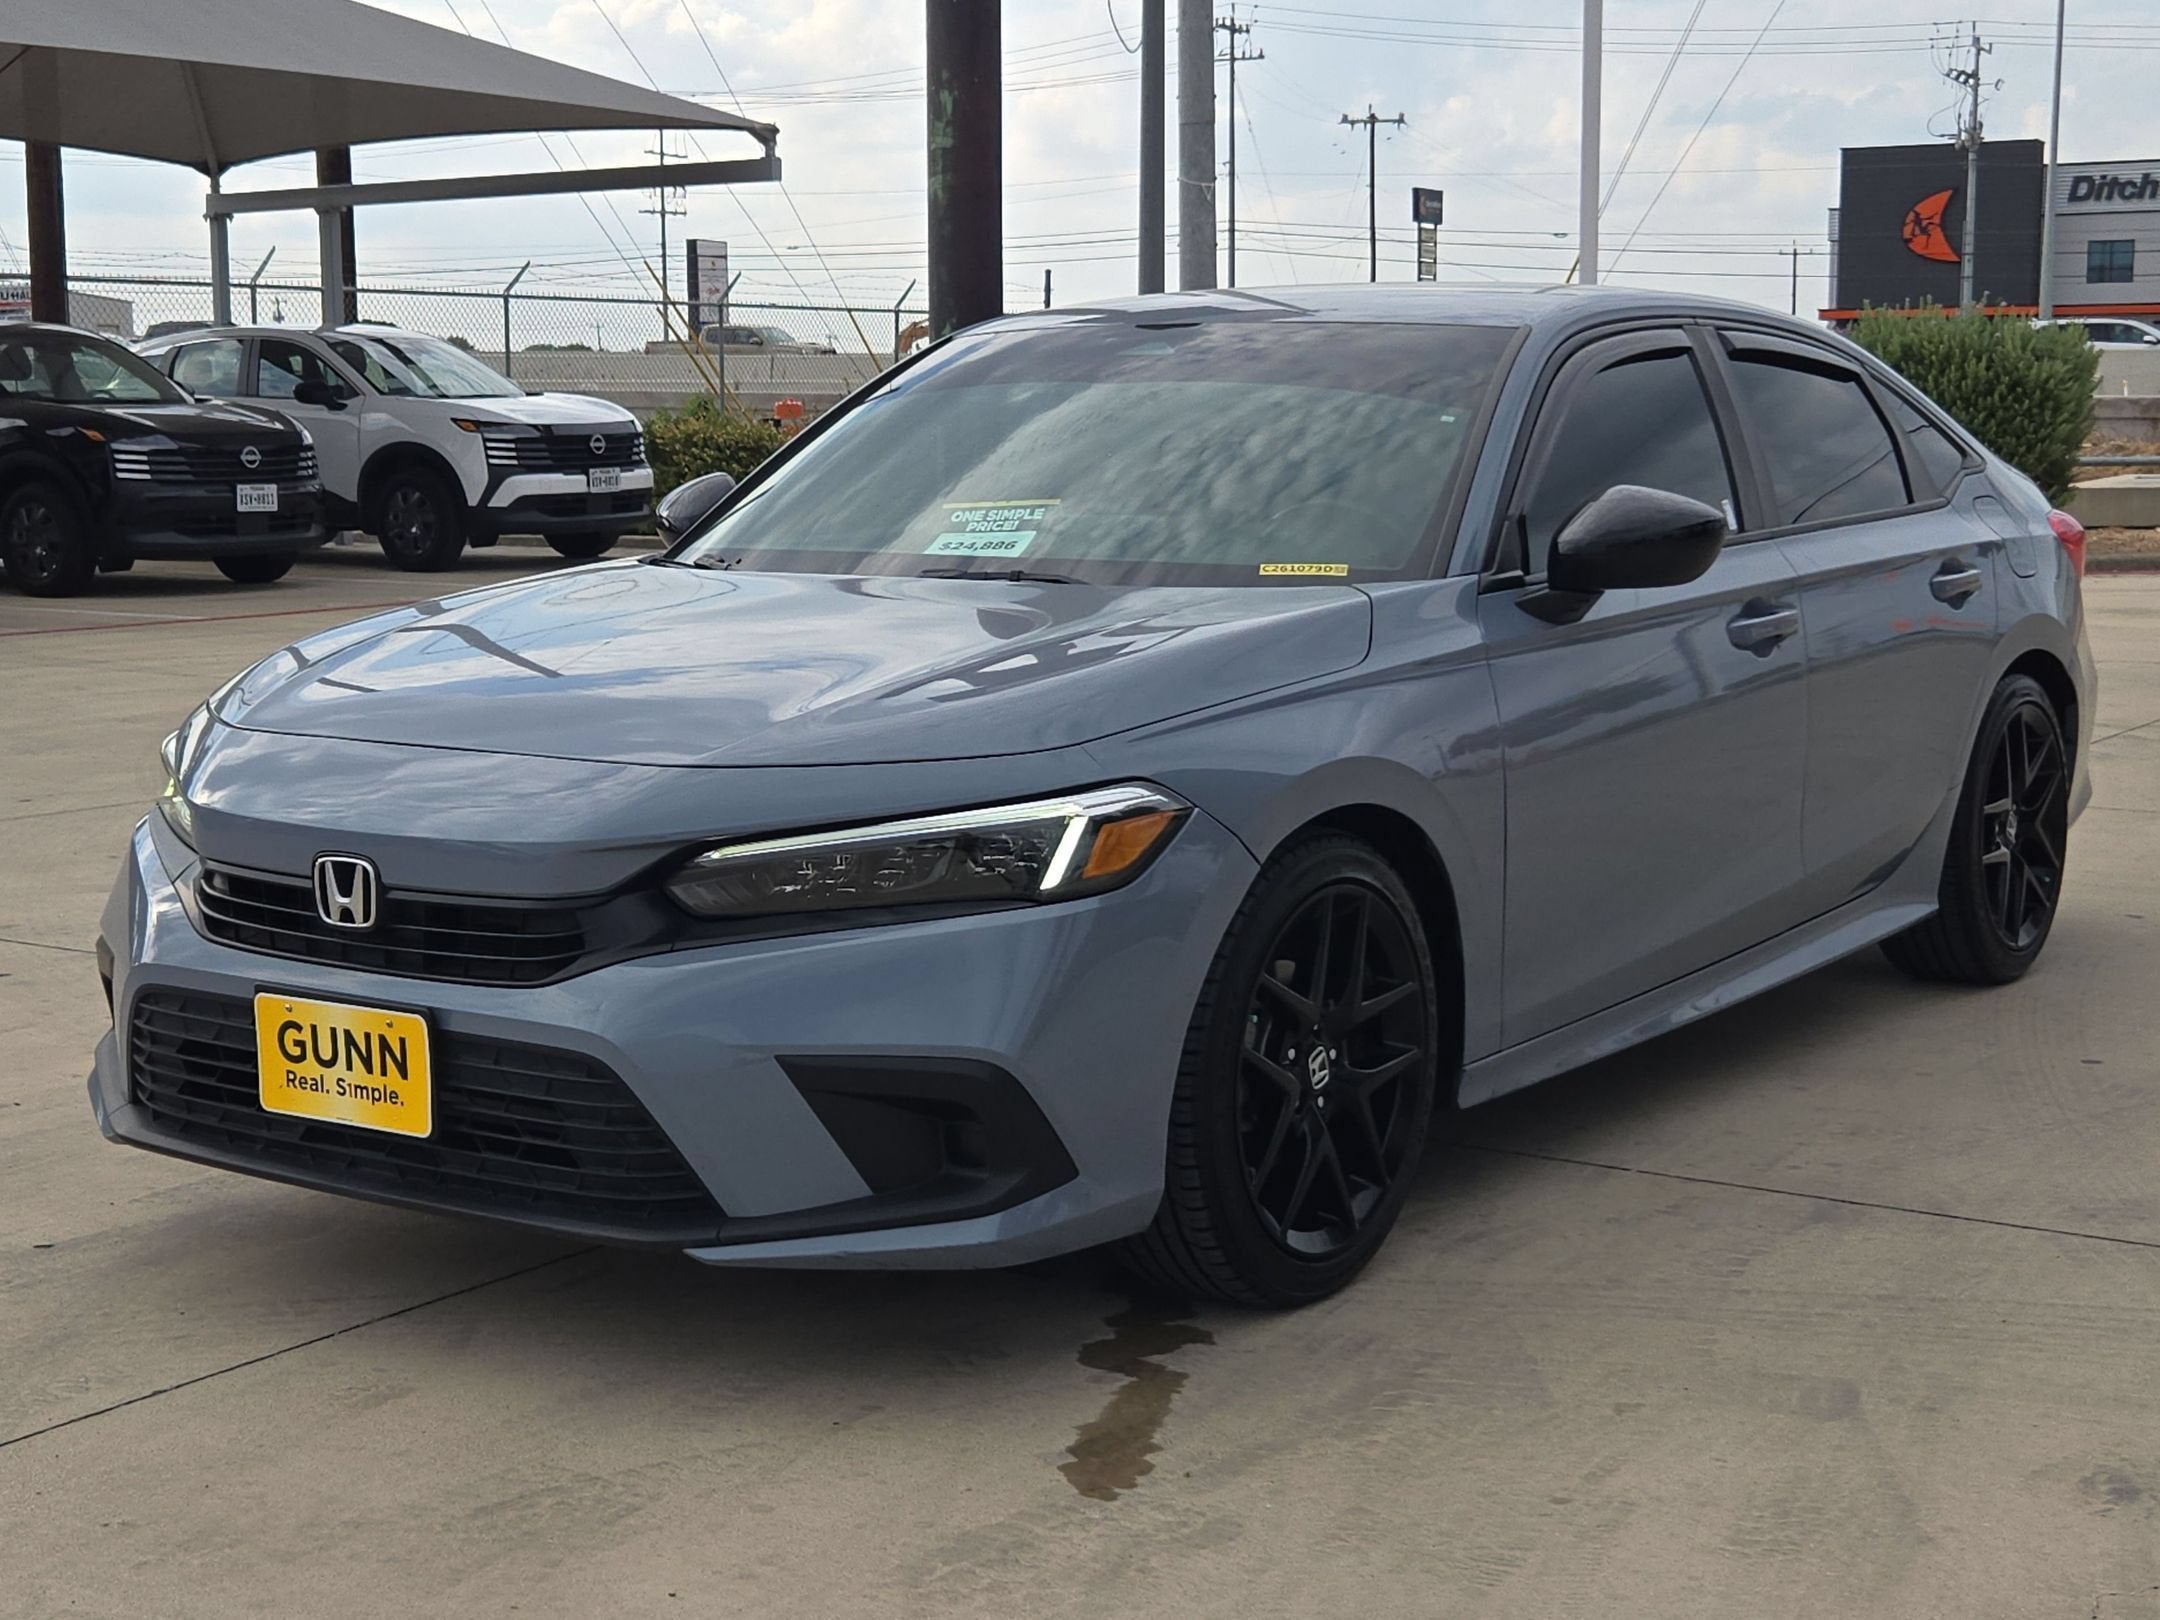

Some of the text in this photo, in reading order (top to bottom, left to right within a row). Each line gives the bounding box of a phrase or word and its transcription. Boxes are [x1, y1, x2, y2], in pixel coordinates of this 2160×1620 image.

[2067, 173, 2160, 202] Ditch
[951, 508, 1046, 522] ONE SIMPLE
[965, 520, 1020, 532] PRICE!
[938, 540, 1018, 552] $24,886
[277, 1019, 409, 1081] GUNN
[285, 1069, 405, 1107] Real. Simple.
